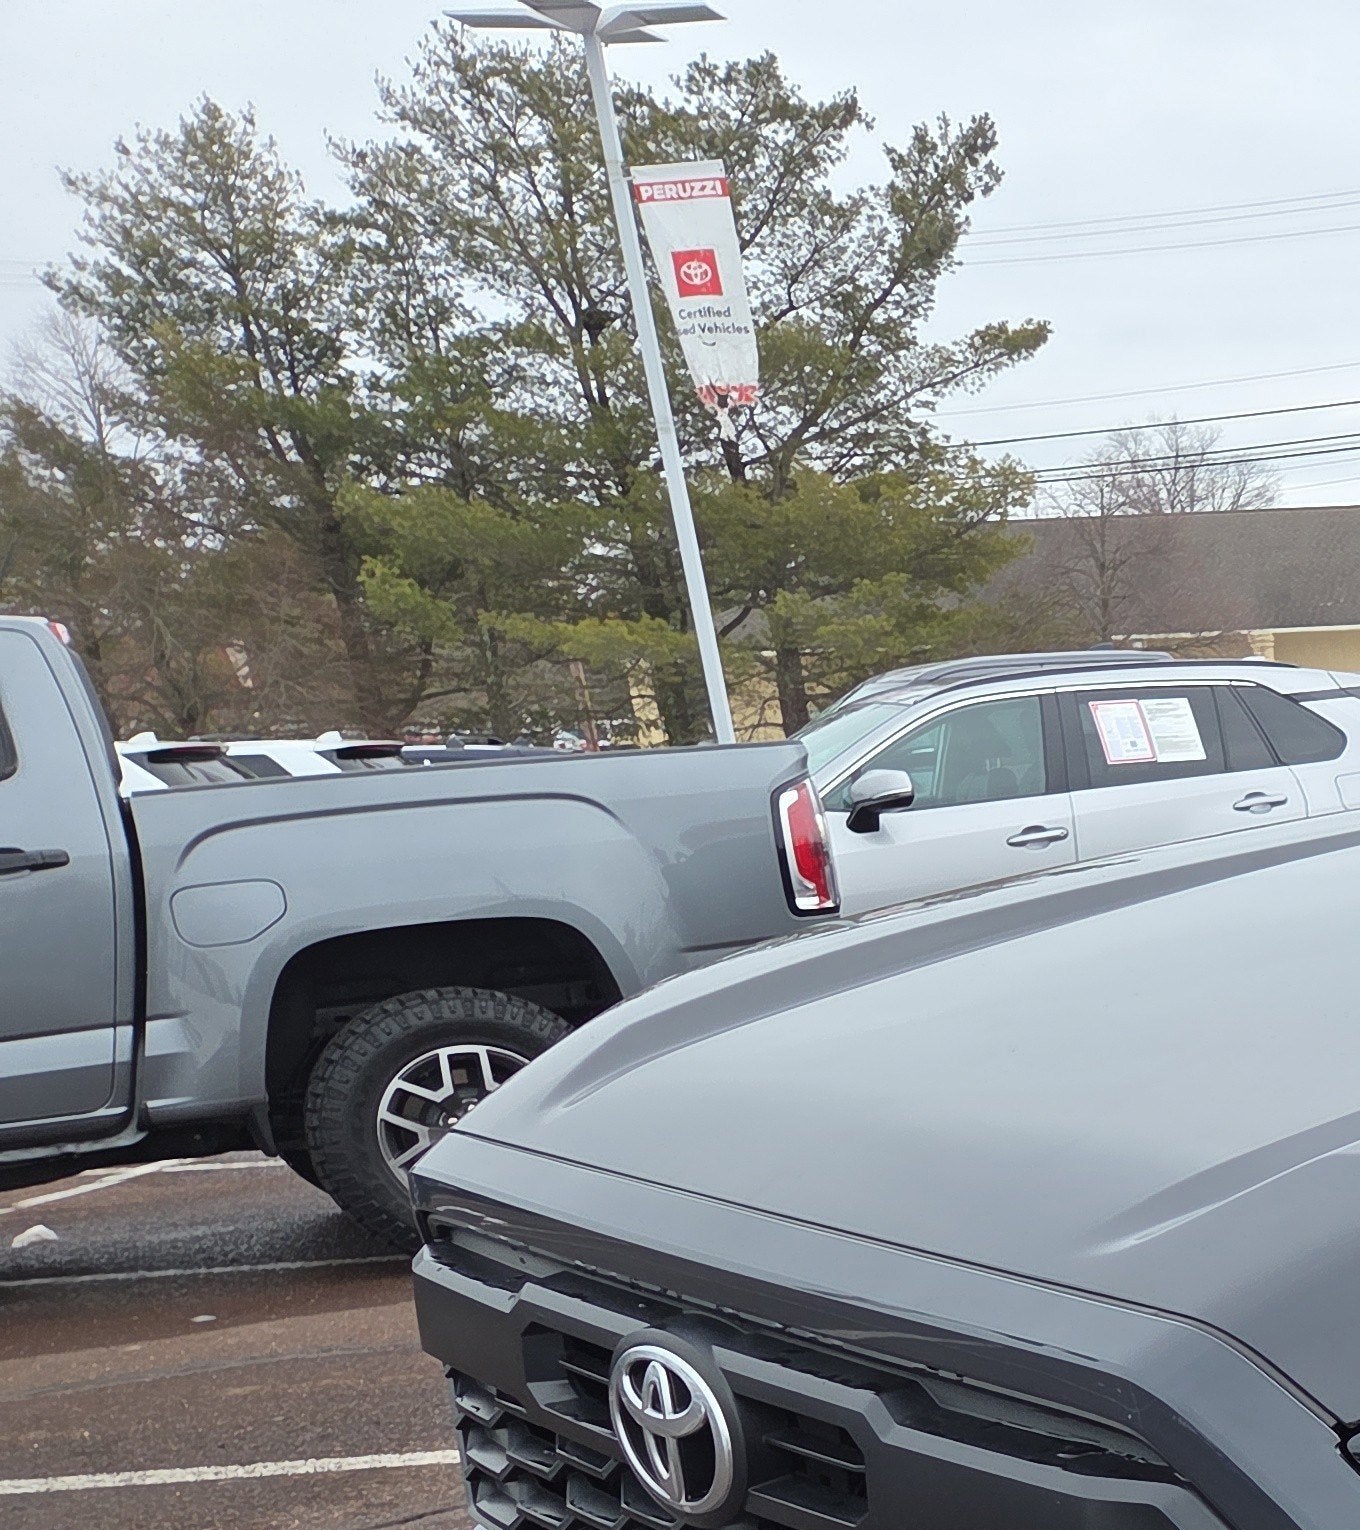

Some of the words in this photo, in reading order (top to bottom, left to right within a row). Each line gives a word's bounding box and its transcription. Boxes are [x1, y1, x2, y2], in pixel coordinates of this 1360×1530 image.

[640, 180, 723, 201] PERUZZI
[678, 306, 731, 321] Certified
[676, 323, 696, 336] sed
[698, 321, 750, 335] Vehicles
